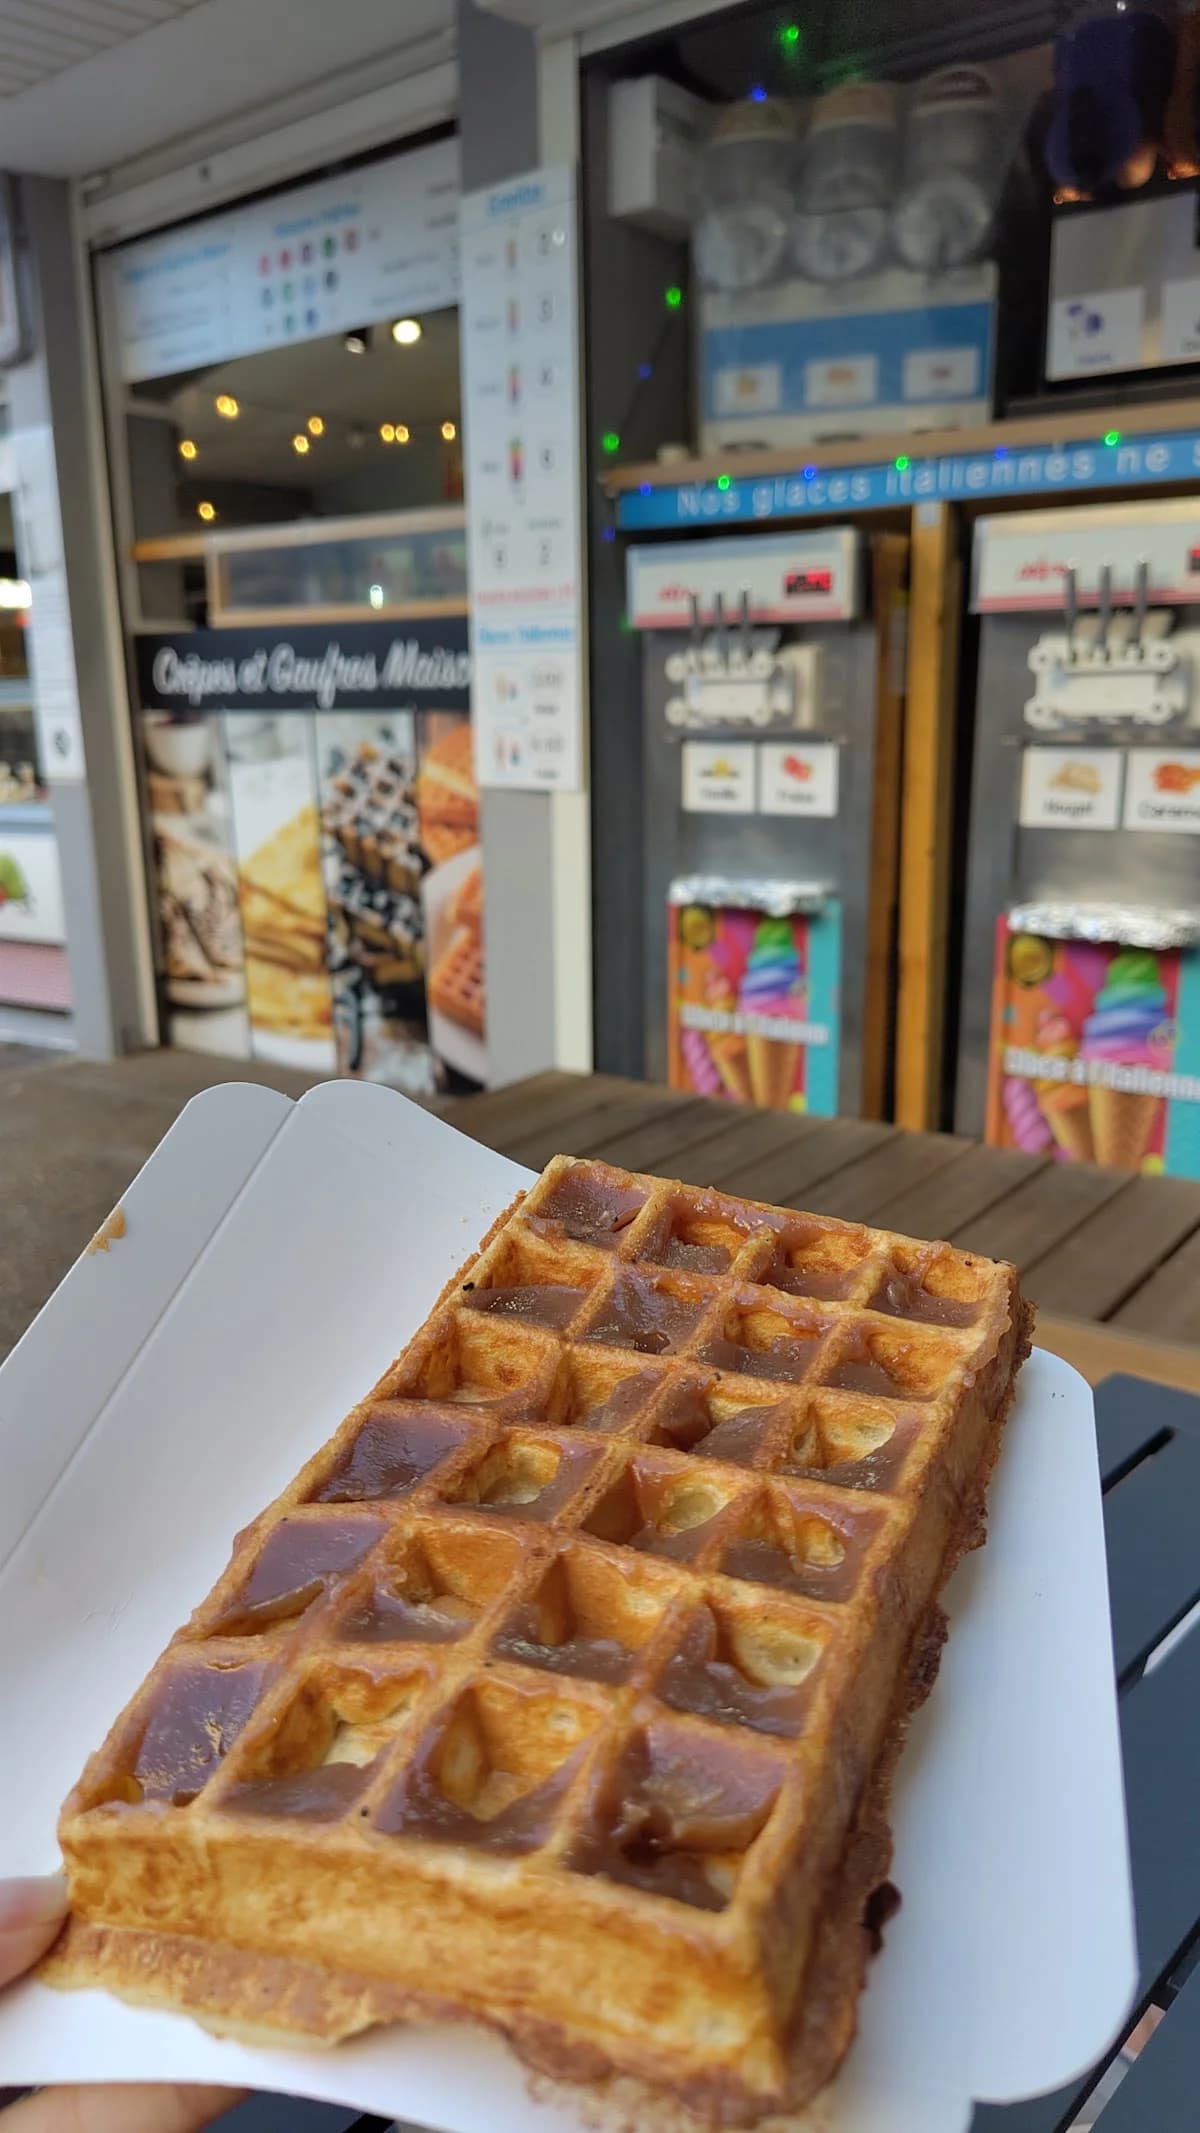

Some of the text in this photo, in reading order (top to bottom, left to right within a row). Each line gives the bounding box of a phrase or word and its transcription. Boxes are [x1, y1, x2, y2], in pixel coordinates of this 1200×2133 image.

[677, 484, 741, 518] Nos
[752, 474, 871, 518] glaces
[1117, 442, 1170, 475] ne
[268, 642, 378, 709] Gaufres
